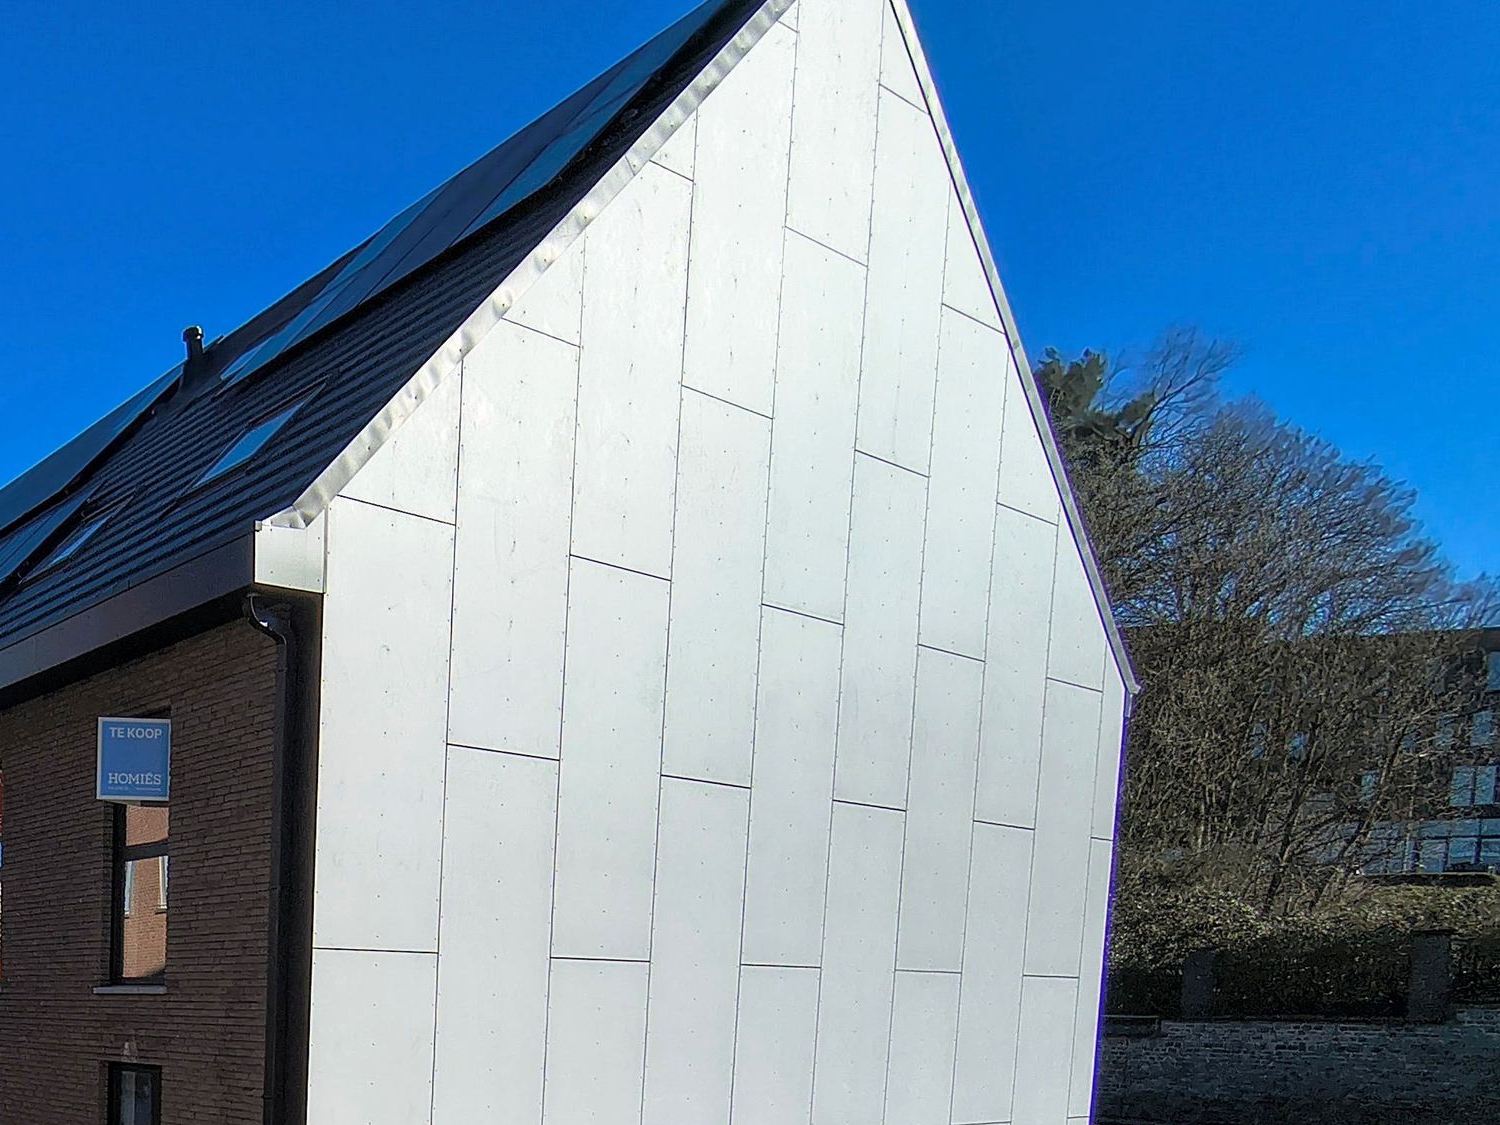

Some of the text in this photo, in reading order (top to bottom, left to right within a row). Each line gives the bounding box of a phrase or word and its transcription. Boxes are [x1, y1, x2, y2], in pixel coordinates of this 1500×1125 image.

[109, 727, 162, 739] TE KOOP
[108, 772, 161, 785] HOMIÉS
